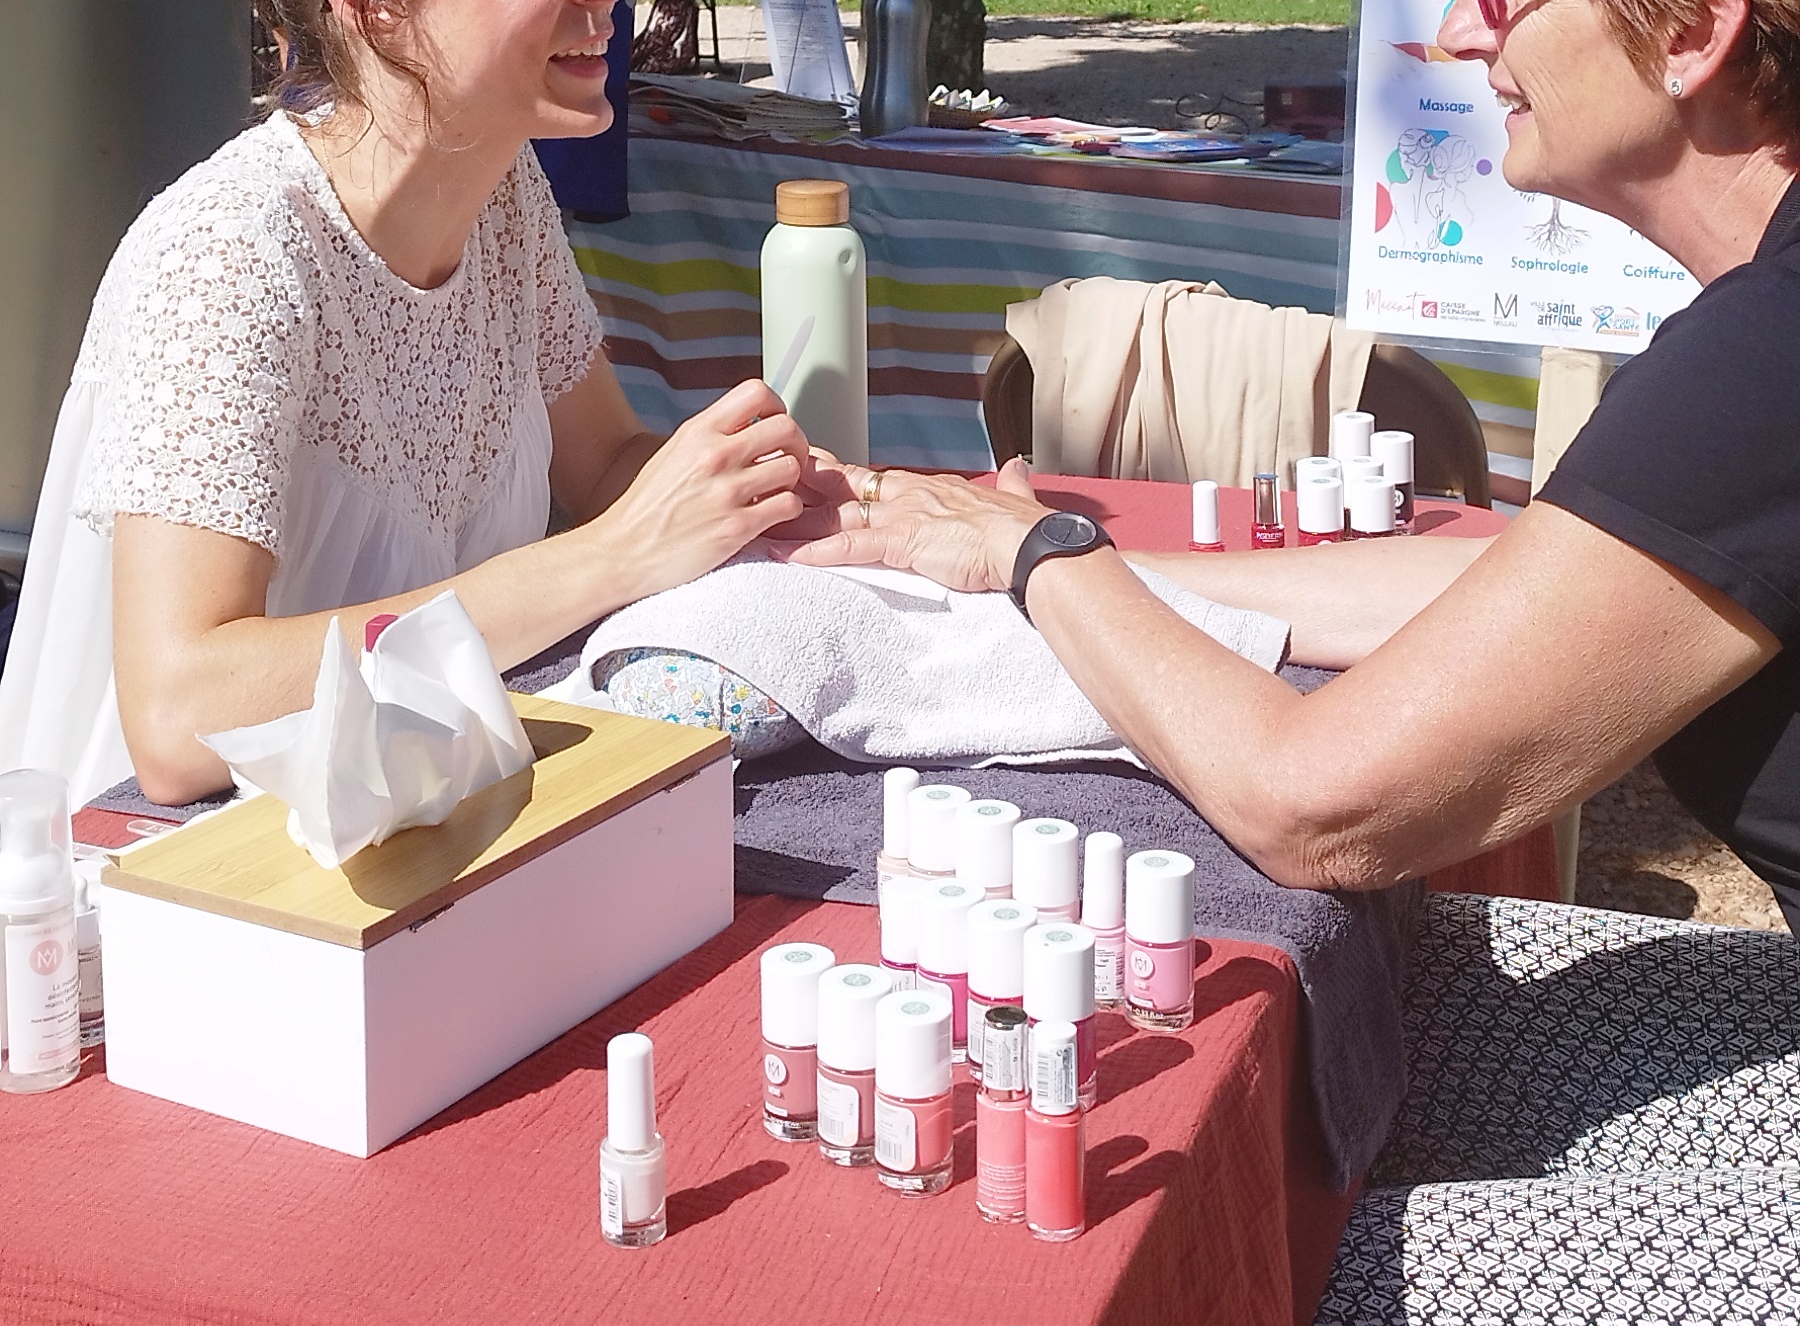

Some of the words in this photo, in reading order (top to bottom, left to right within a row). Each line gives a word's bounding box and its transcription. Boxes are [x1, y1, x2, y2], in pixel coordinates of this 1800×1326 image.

[1419, 97, 1474, 114] Massage
[1378, 245, 1484, 266] Dermographisme
[1511, 256, 1589, 275] Sophrologie
[1623, 264, 1686, 282] Coiffure
[1547, 299, 1576, 316] saint
[1537, 313, 1583, 328] affrique
